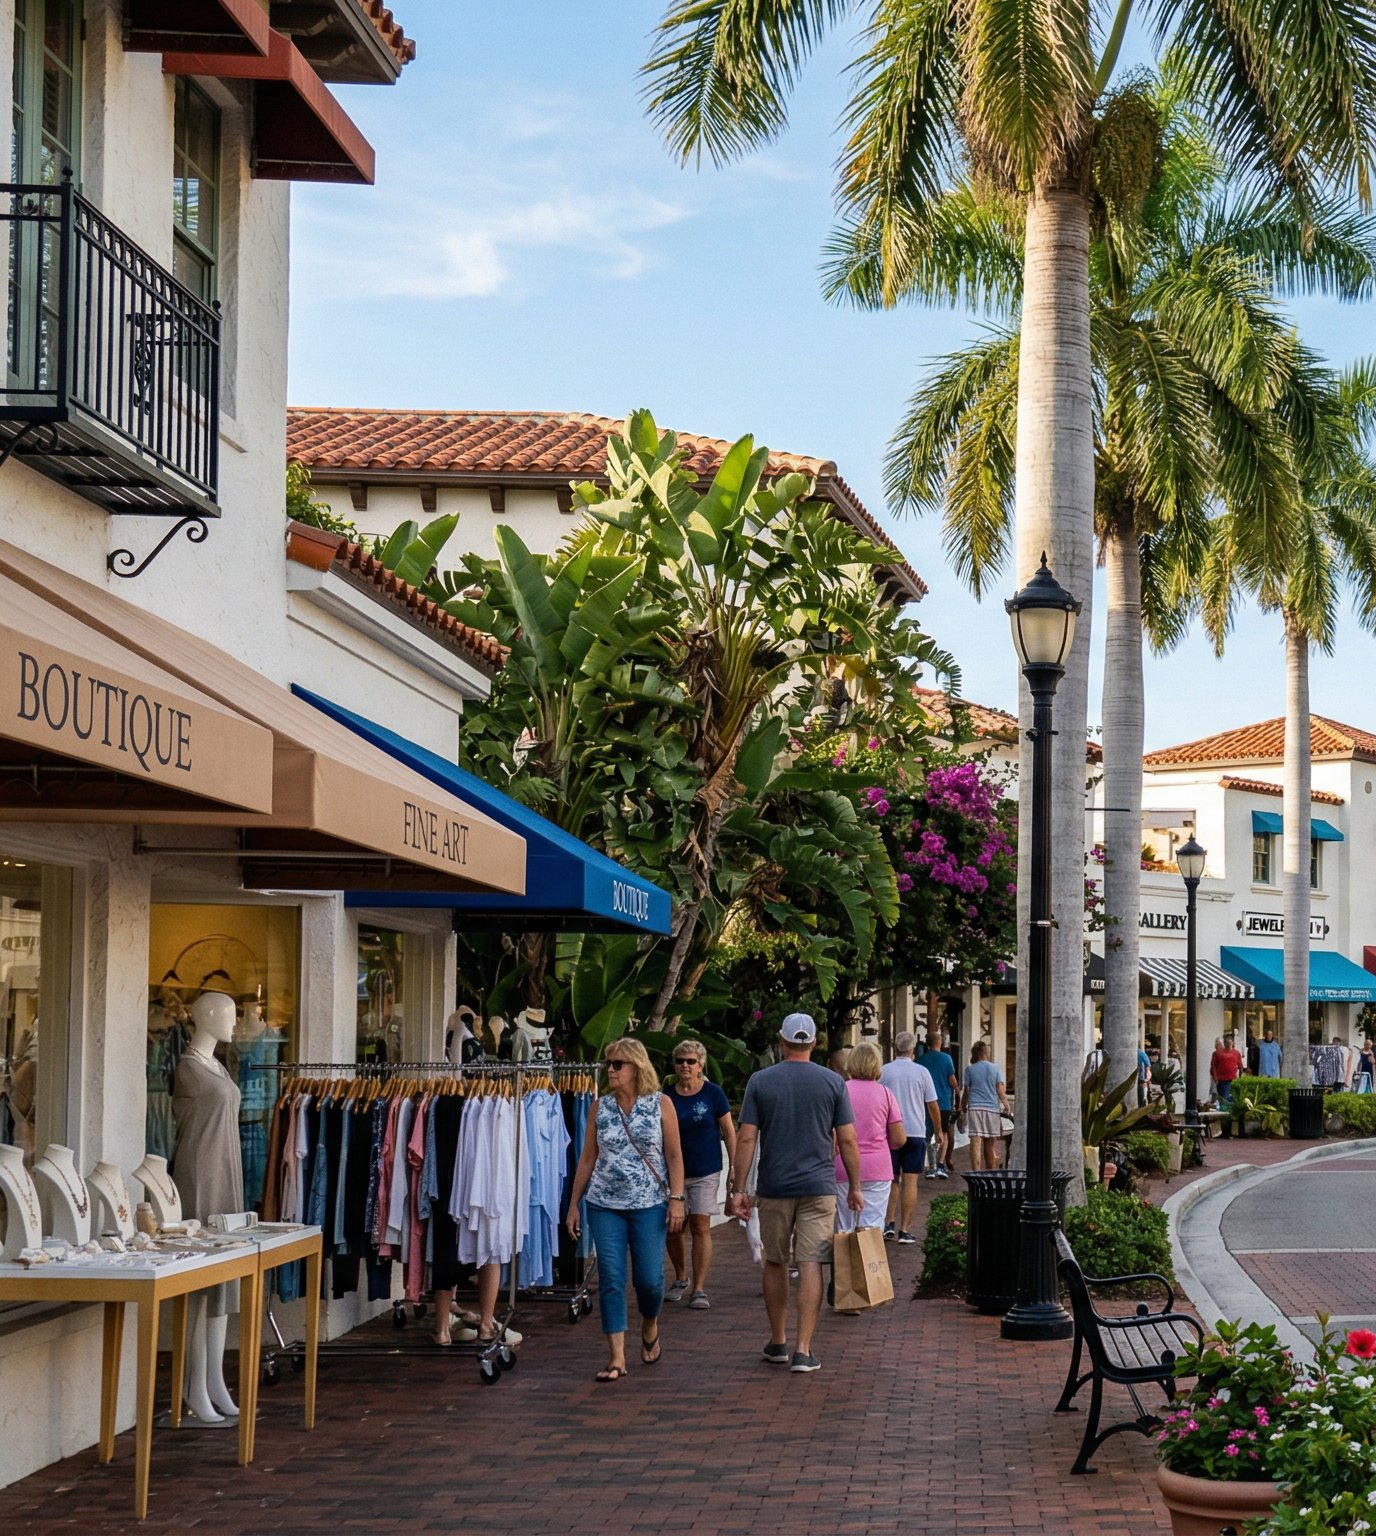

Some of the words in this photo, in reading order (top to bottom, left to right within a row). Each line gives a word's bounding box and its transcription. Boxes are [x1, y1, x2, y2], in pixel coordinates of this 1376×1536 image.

[17, 651, 193, 772] BOUTIQUE
[403, 801, 438, 858] FINE
[441, 814, 469, 865] ART
[613, 879, 649, 922] BOUTIQUE
[1138, 912, 1187, 930] ALLERY
